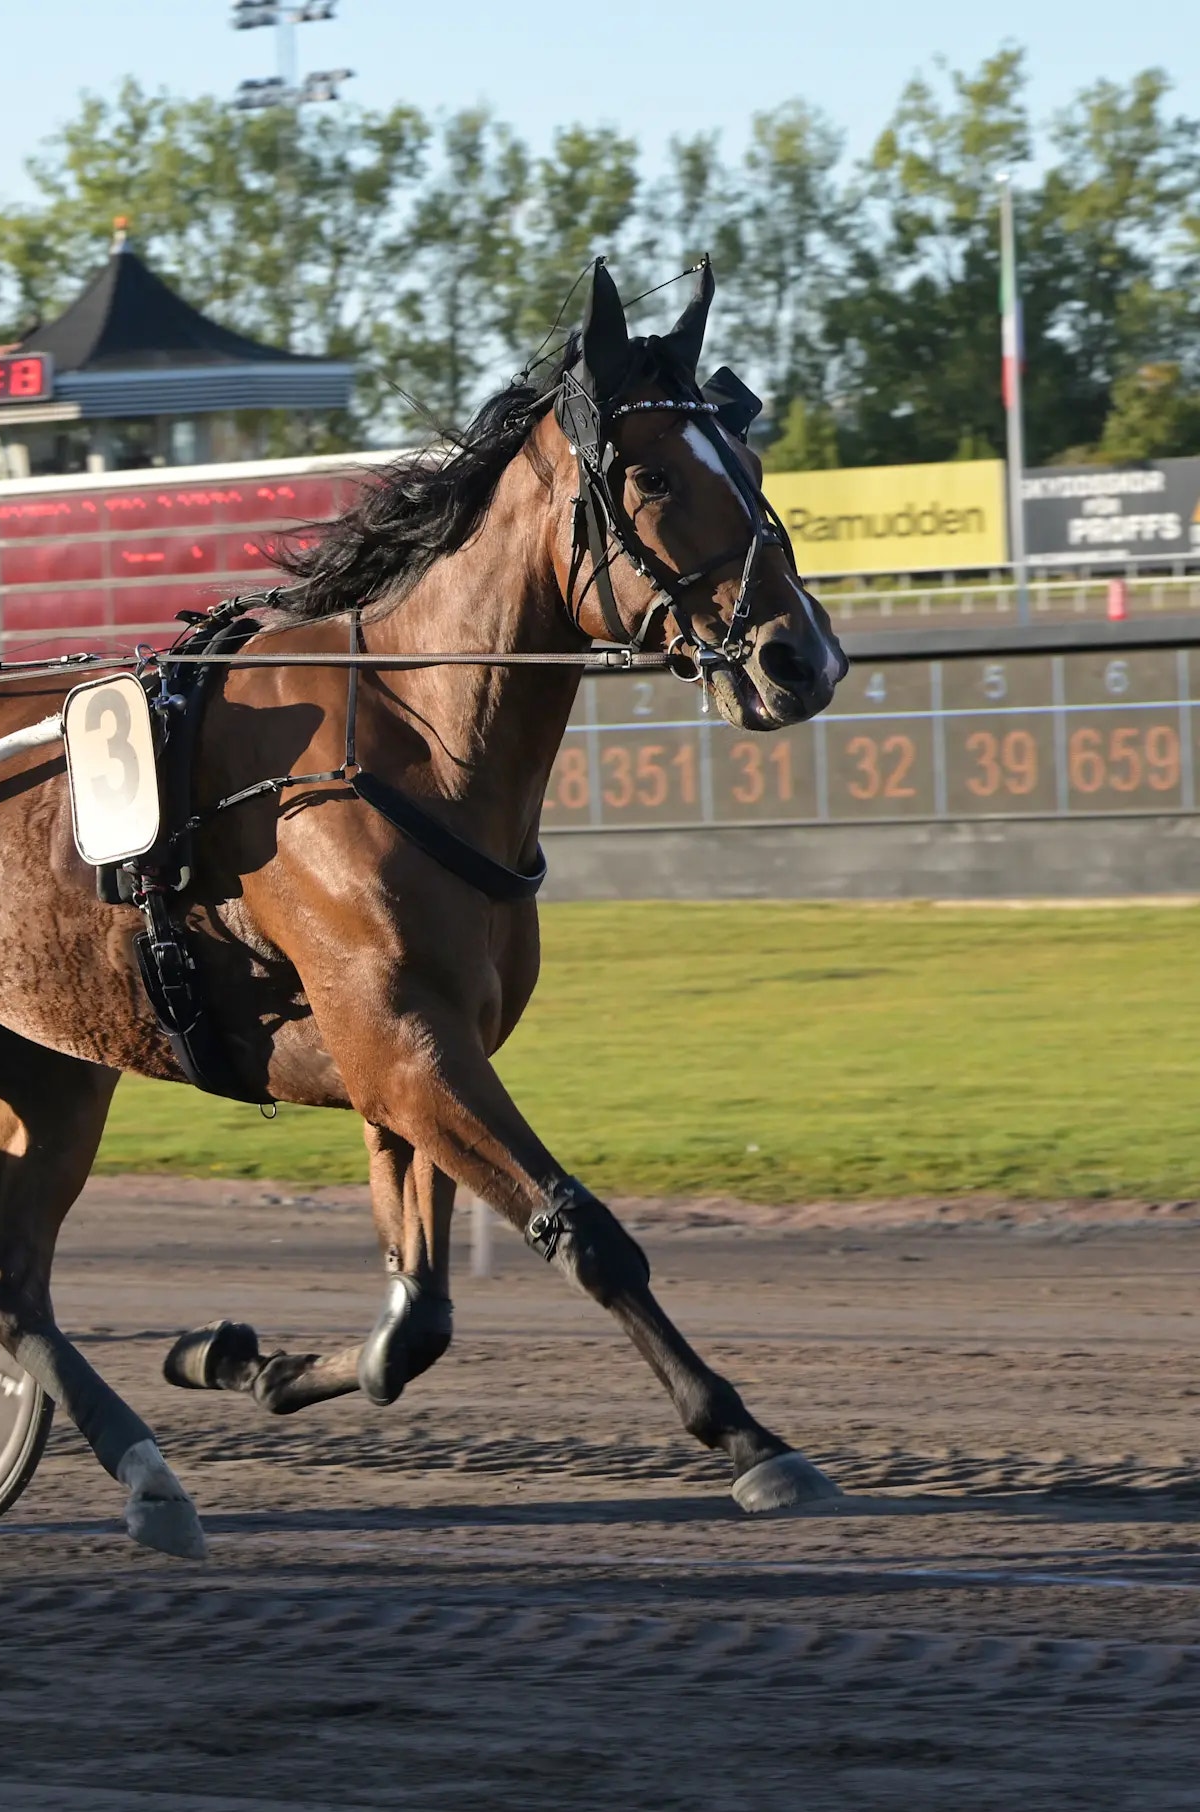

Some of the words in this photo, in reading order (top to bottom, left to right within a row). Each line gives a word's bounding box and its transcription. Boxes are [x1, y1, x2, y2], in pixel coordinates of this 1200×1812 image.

[786, 501, 985, 541] Ramudden
[1068, 512, 1182, 545] PROFFS
[632, 682, 653, 715] 2
[864, 672, 887, 702] 4
[982, 663, 1008, 699] 5
[1104, 660, 1130, 693] 6
[85, 688, 140, 811] 3
[542, 747, 589, 808] 8
[602, 745, 696, 807] 351
[730, 740, 793, 803] 31
[845, 735, 917, 799] 32
[964, 729, 1037, 796] 39
[1069, 725, 1180, 793] 659
